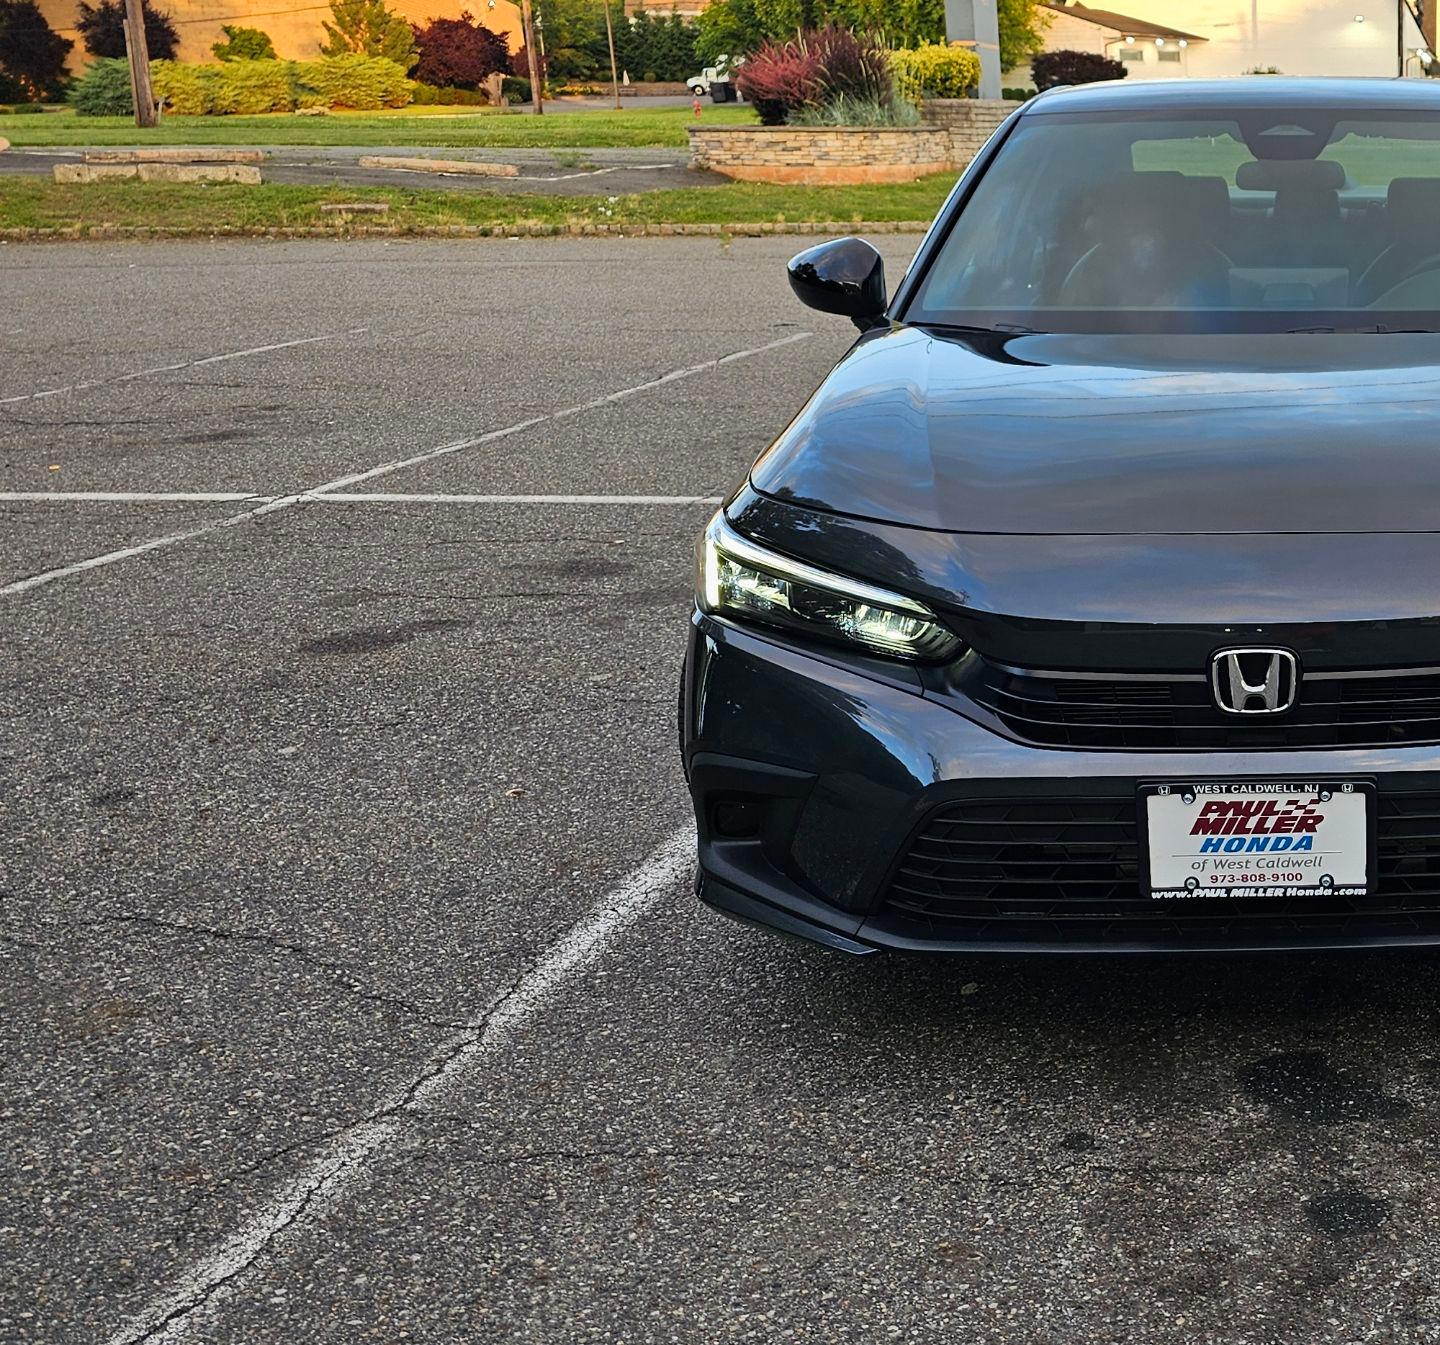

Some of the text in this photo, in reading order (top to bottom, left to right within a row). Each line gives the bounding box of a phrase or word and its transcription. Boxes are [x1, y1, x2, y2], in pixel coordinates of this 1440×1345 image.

[1193, 784, 1320, 794] WEST CALDWELL, NJ
[1199, 800, 1282, 817] PAUL
[1189, 815, 1325, 836] MILLER
[1199, 835, 1314, 853] HONDA
[1191, 856, 1323, 872] of West Caldwell
[1210, 872, 1303, 884] 973-808-9100
[1151, 887, 1228, 899] www.PAUL
[1229, 887, 1285, 898] MILLER
